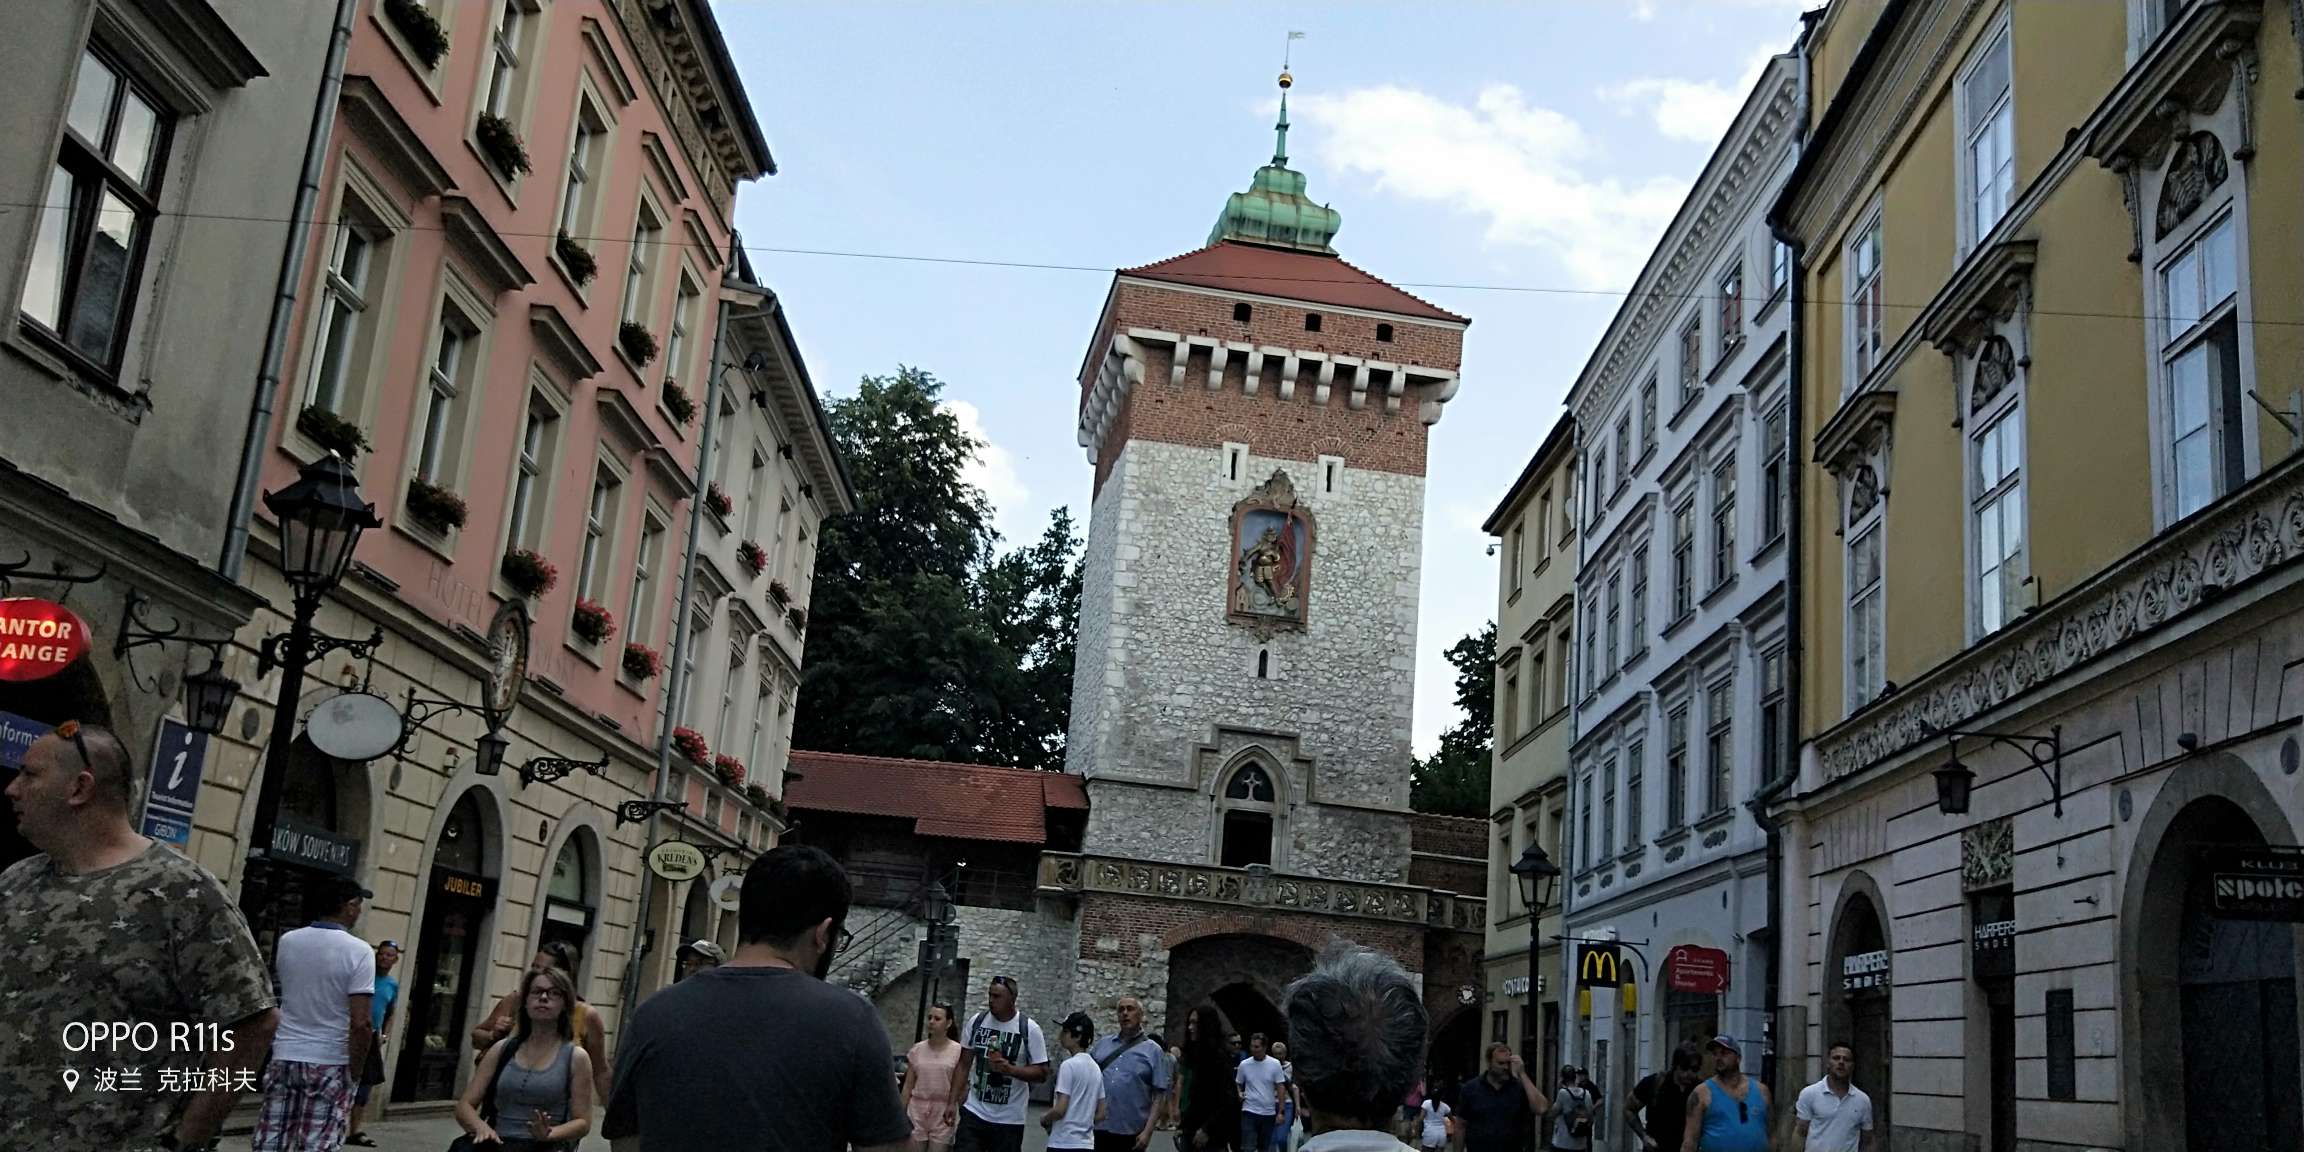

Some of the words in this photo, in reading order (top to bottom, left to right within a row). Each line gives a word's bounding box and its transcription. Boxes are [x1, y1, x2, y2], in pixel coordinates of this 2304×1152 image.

[0, 643, 69, 662] ANGE
[443, 876, 483, 897] JUBILER
[1975, 920, 2016, 940] HARPERS
